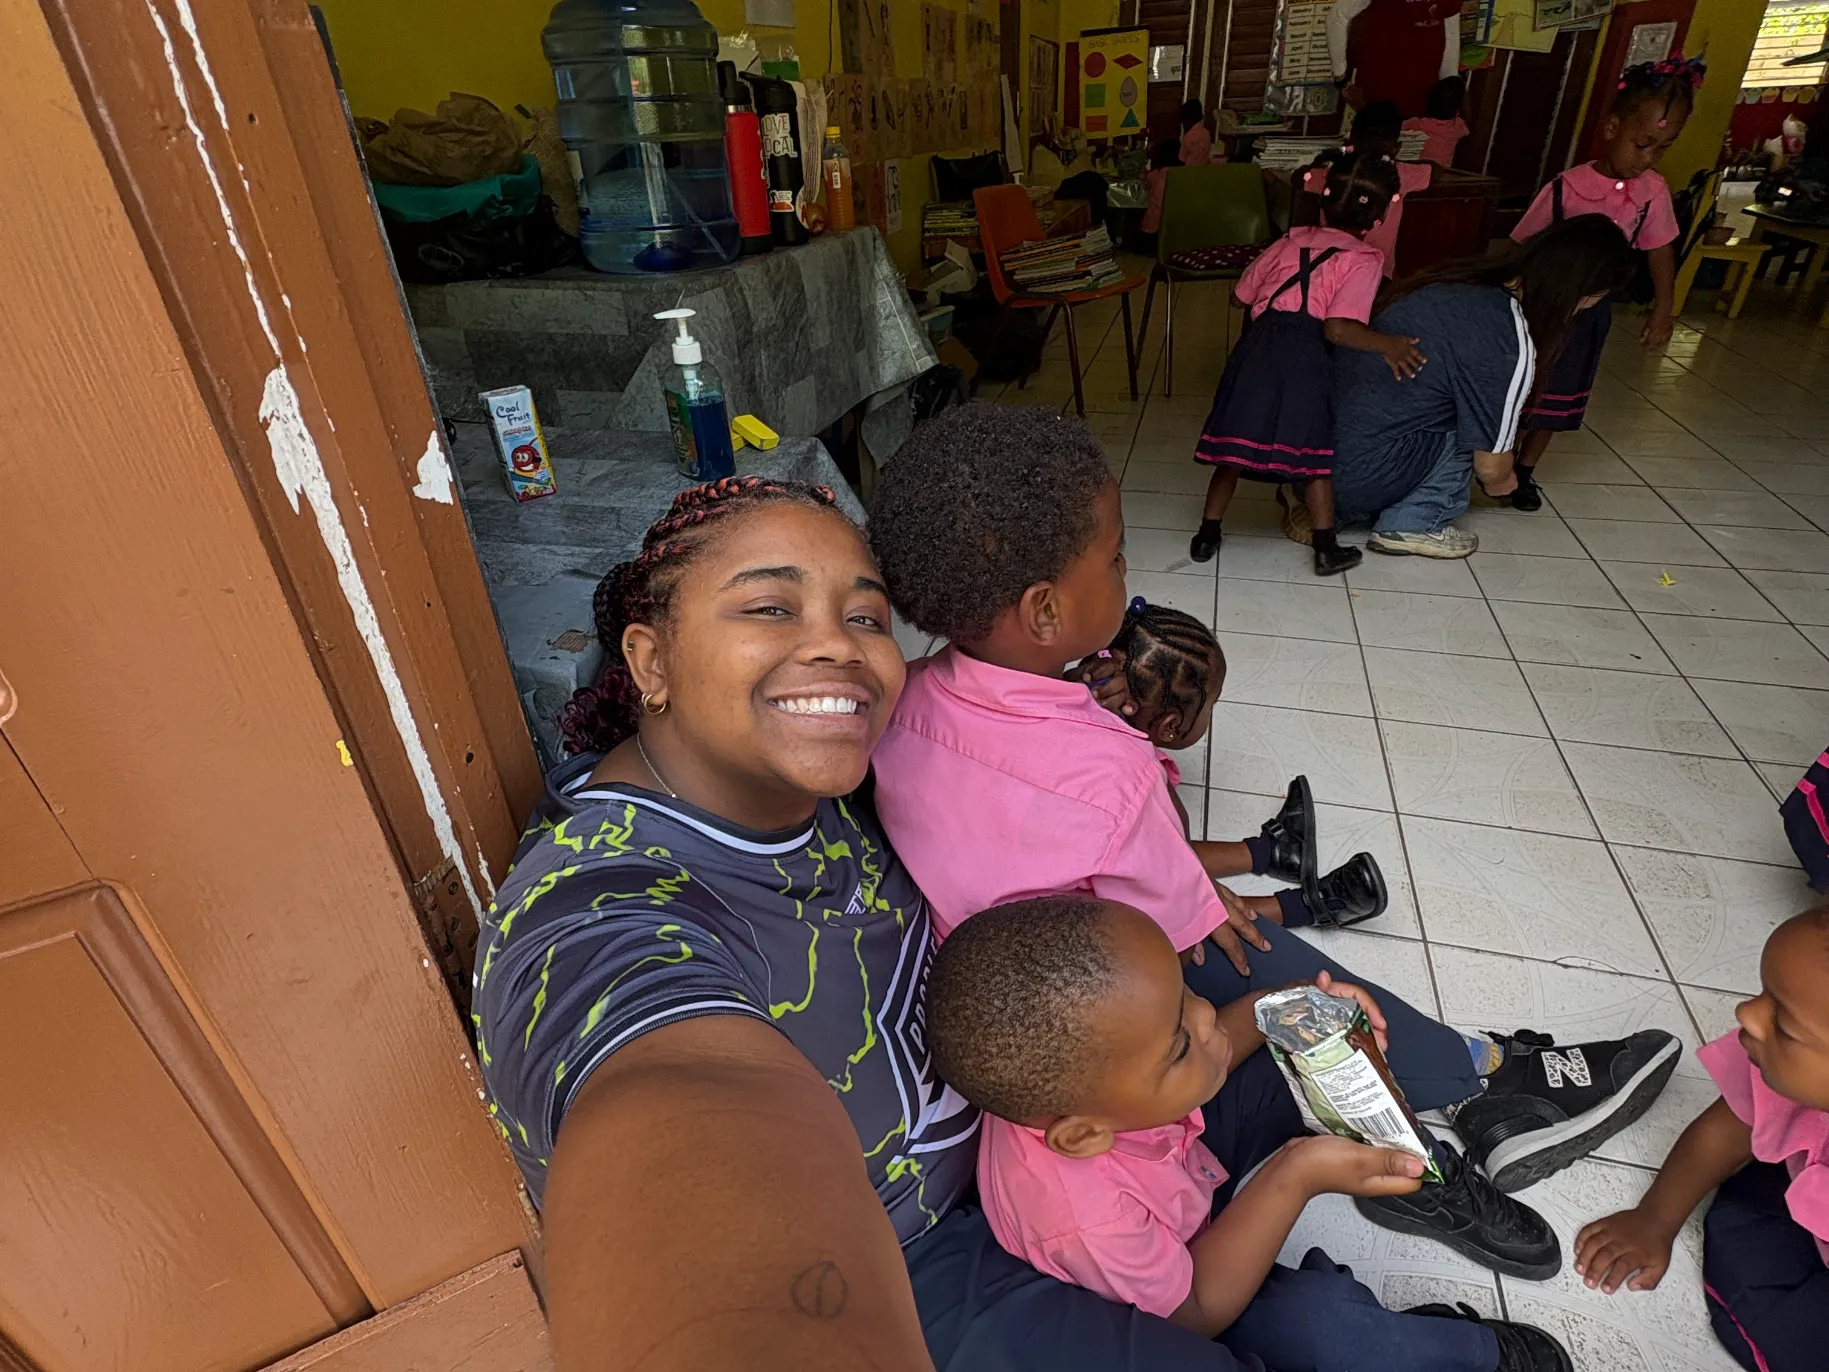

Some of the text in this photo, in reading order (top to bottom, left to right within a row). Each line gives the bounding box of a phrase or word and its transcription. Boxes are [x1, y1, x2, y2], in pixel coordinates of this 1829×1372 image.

[762, 114, 789, 136] LOVE
[763, 136, 797, 158] LOCAL
[495, 401, 520, 418] Cool
[507, 413, 530, 427] Fruit
